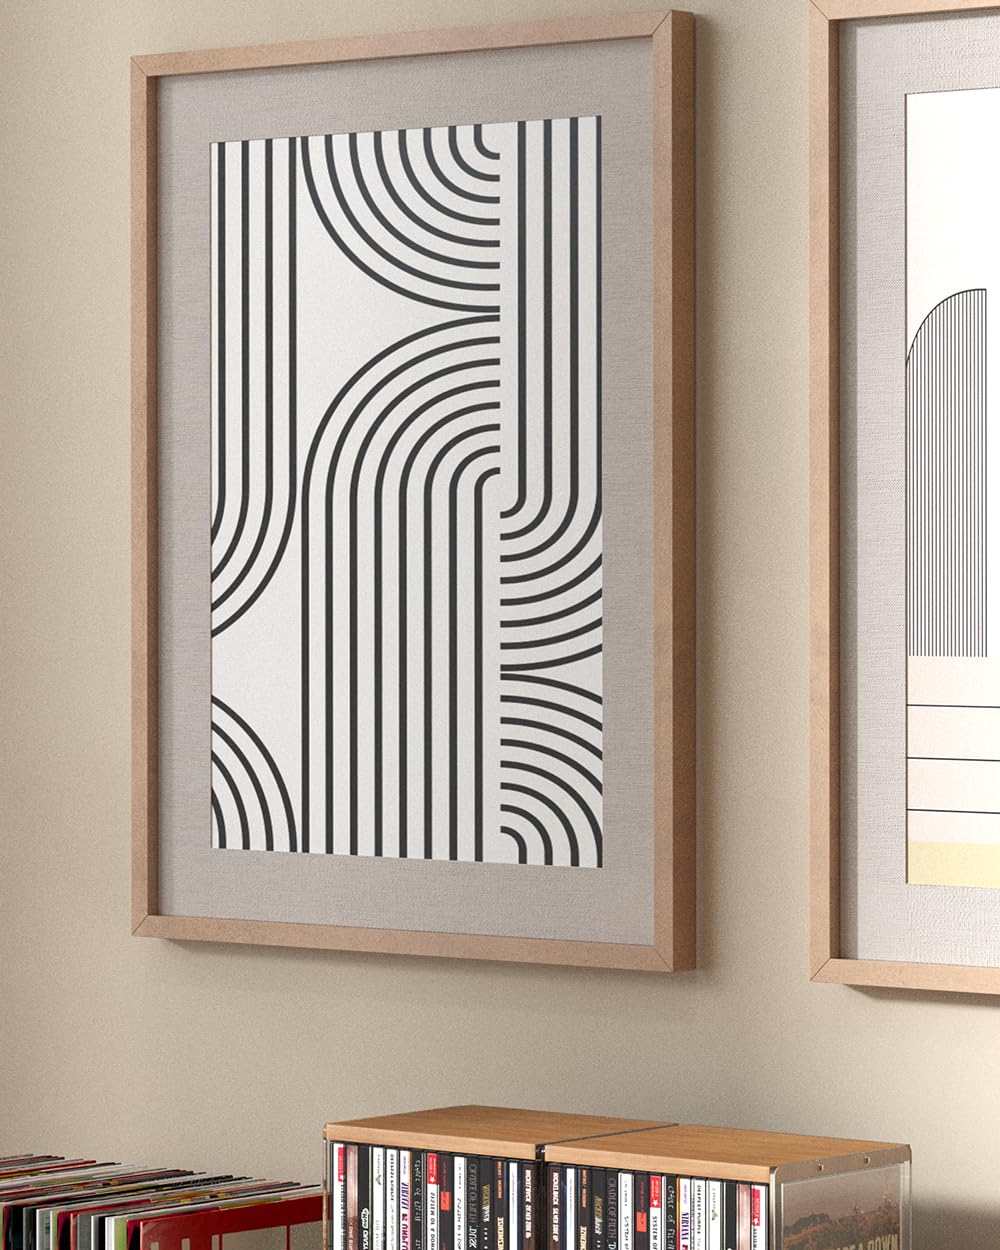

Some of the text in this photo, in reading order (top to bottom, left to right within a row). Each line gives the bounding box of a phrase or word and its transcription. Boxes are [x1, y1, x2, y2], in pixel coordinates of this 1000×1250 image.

[608, 1177, 617, 1203] CRADLE
[608, 1204, 617, 1216] OF
[608, 1218, 617, 1239] FILTH
[681, 1212, 689, 1240] NIRVANA
